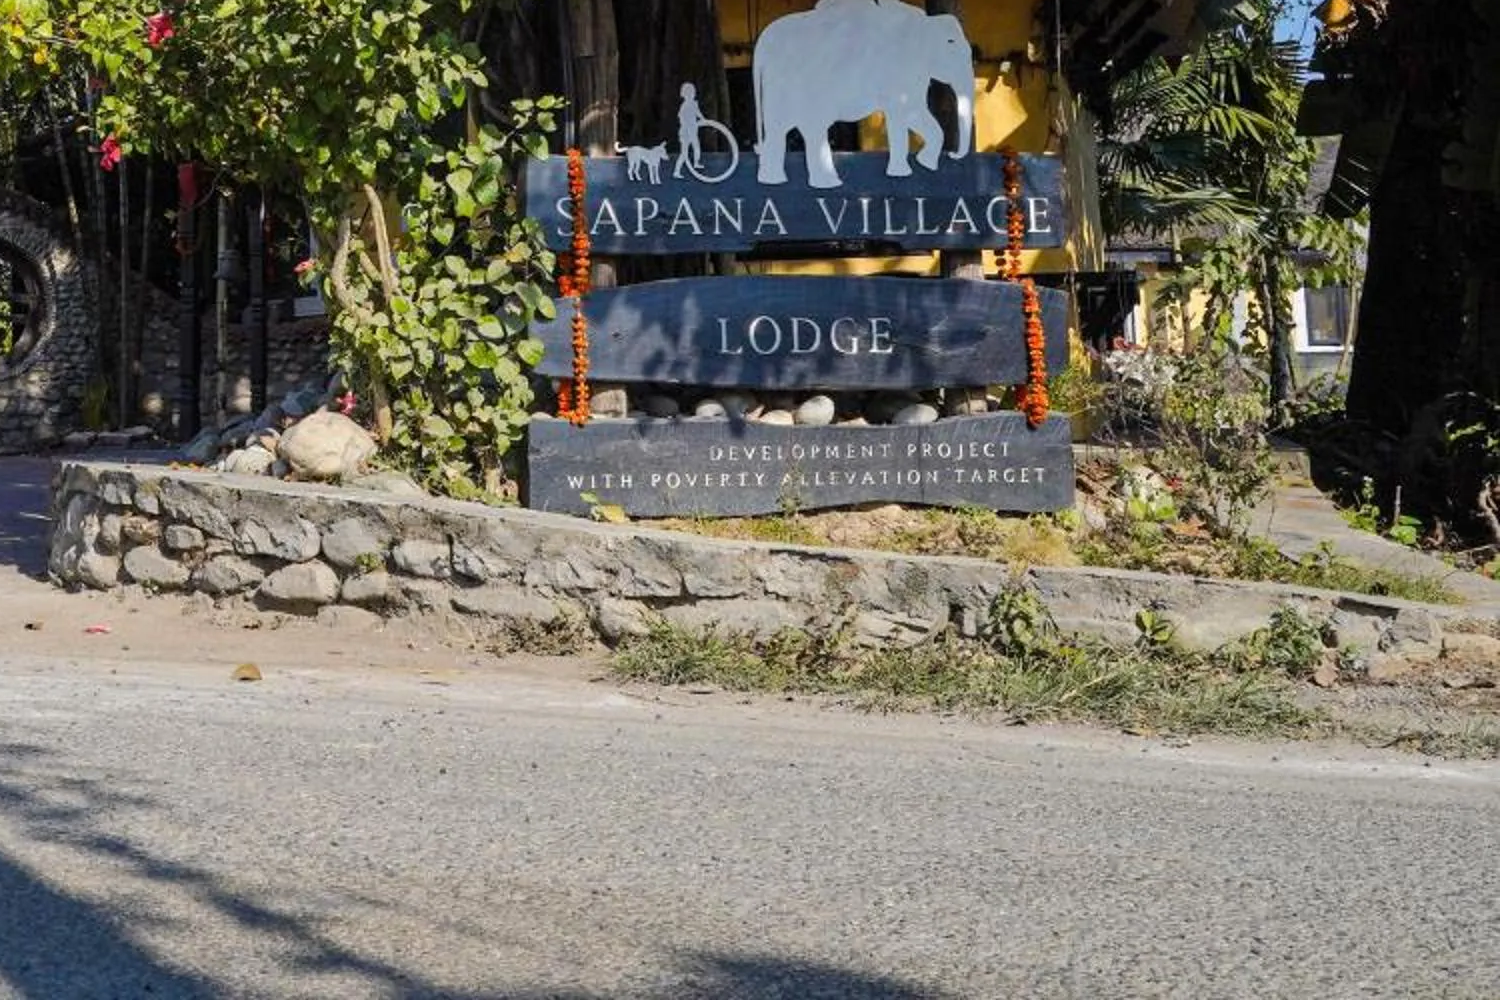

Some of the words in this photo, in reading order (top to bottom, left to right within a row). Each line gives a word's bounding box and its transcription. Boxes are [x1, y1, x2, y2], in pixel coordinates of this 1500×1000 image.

[555, 197, 789, 237] SAPANA
[716, 315, 895, 355] LODGE
[710, 444, 891, 461] DEVELOPMENT
[907, 441, 1011, 460] PROJECT
[567, 473, 633, 489] WITH
[651, 471, 765, 489] POVERTY
[954, 467, 1046, 484] TARGET
